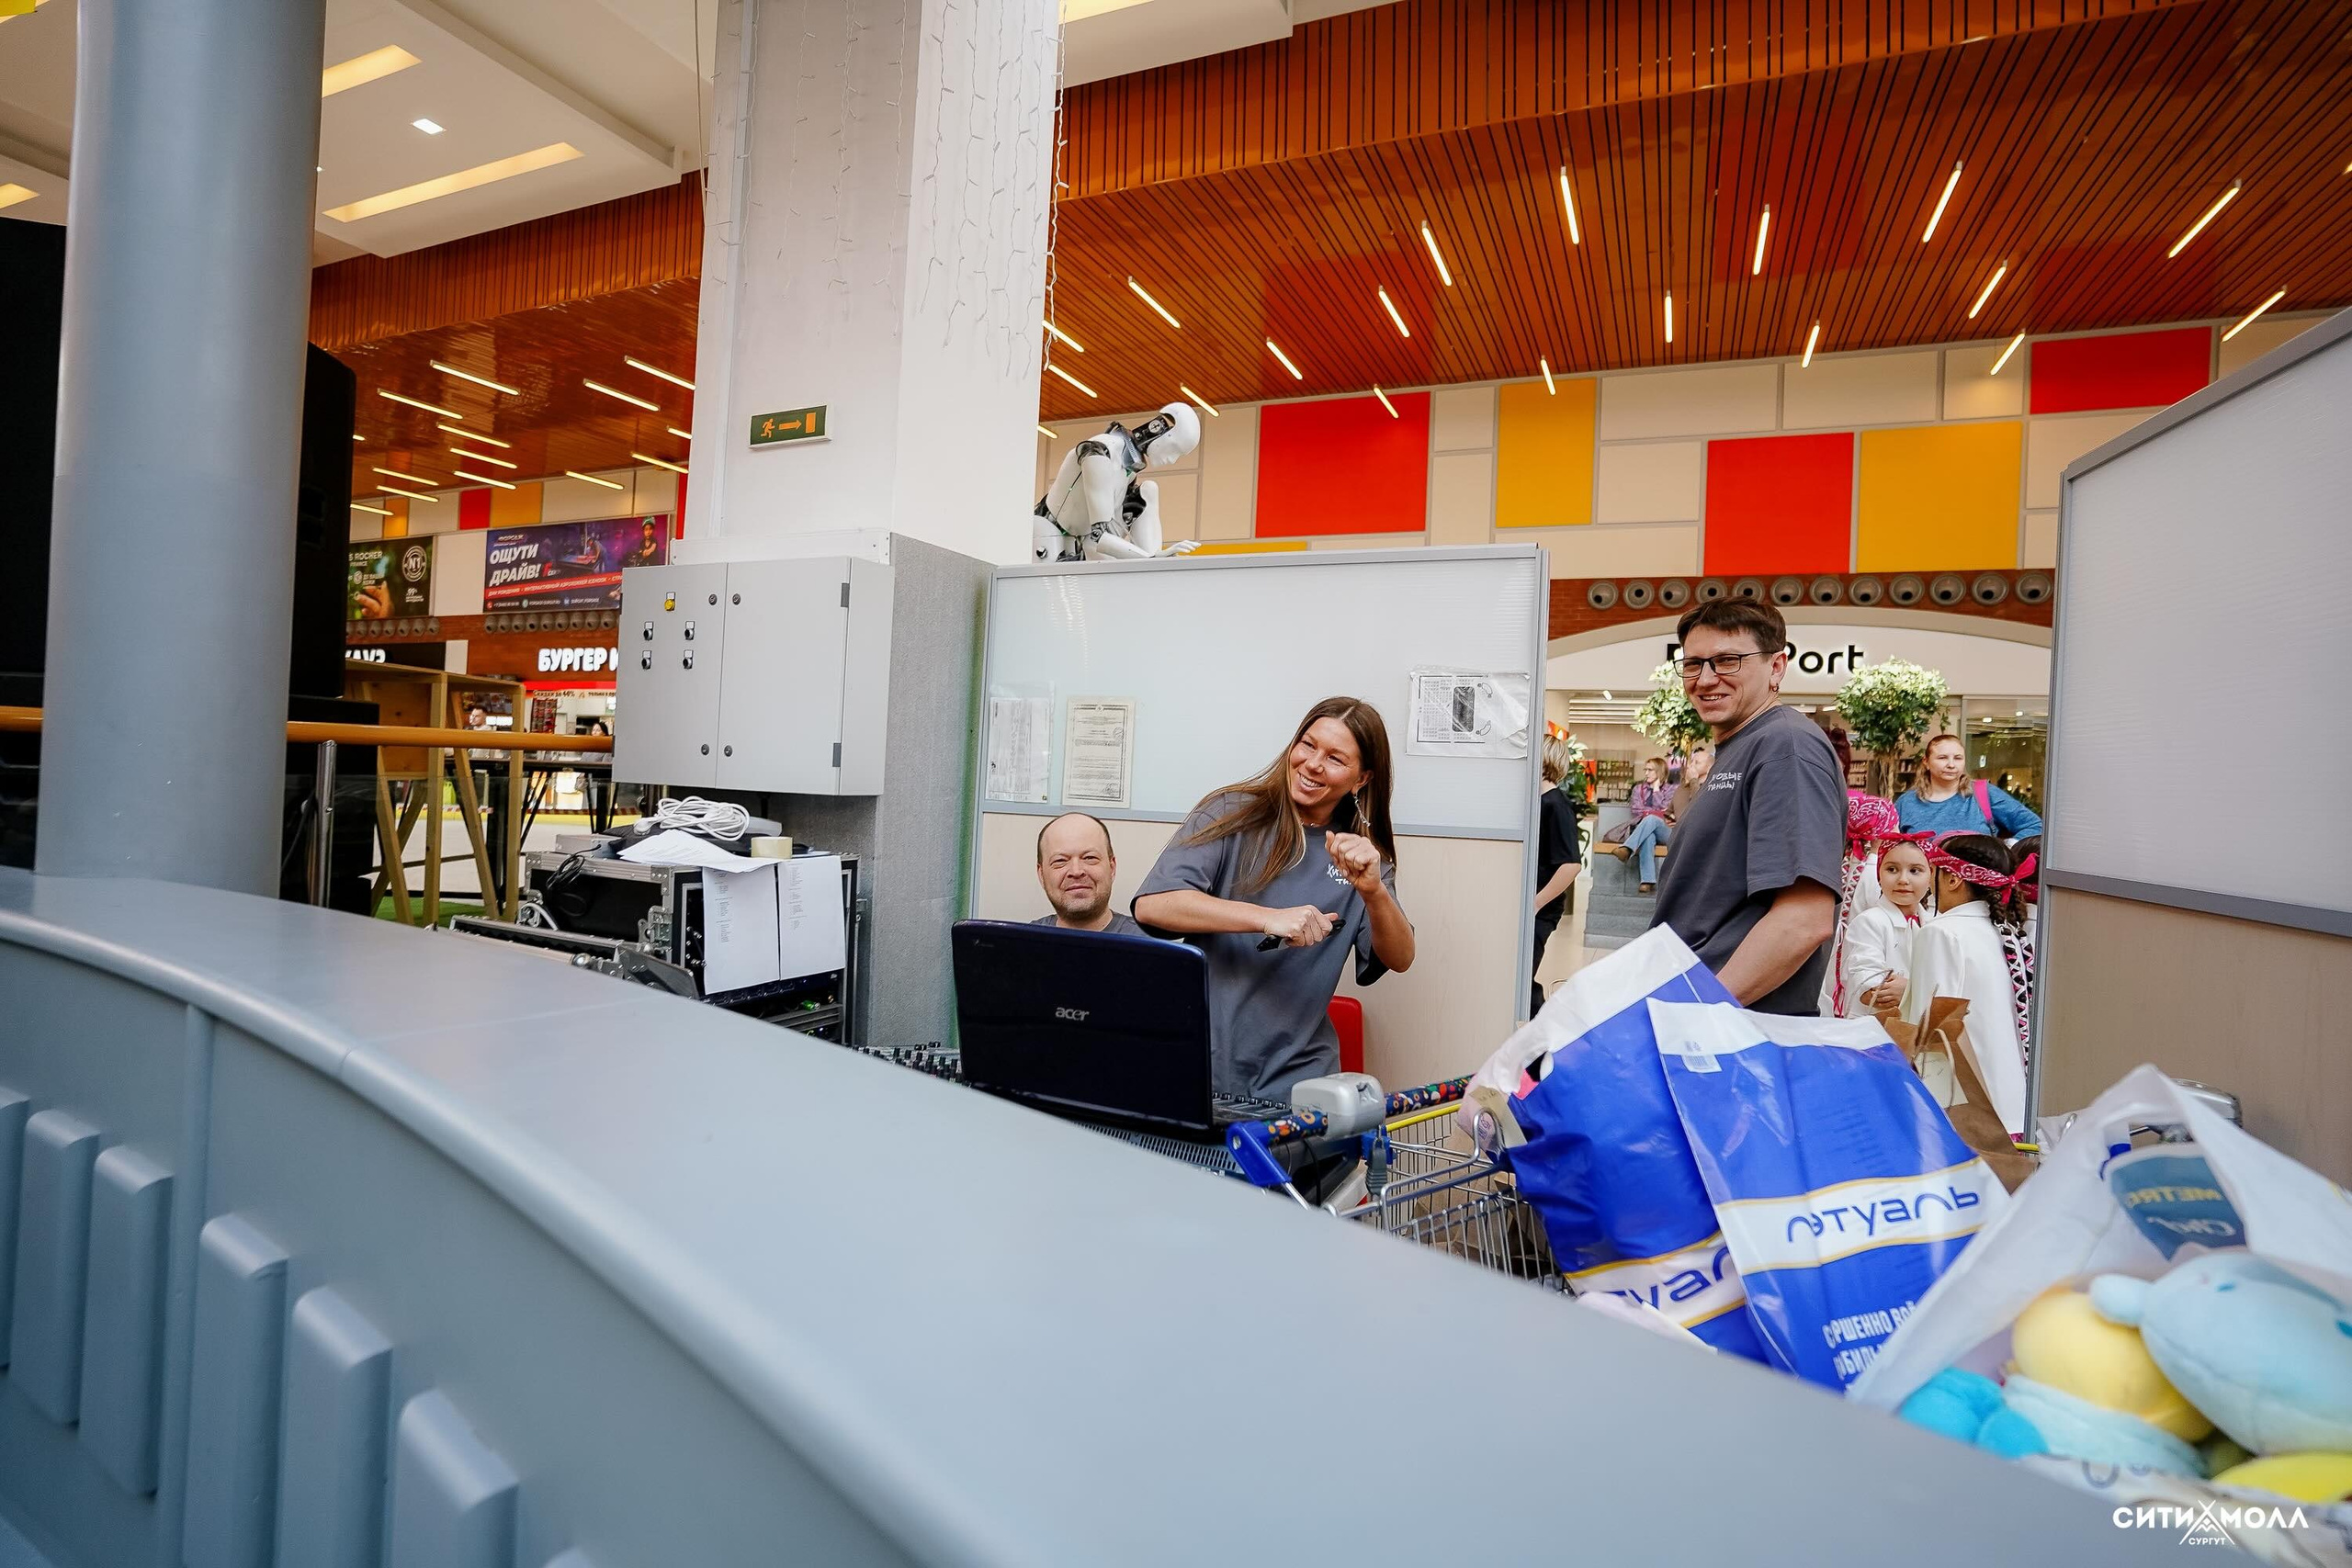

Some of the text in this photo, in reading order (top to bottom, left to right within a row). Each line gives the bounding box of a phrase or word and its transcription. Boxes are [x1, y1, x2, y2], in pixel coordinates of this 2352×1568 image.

[490, 544, 539, 564] ОЩУТИ
[489, 562, 542, 587] ДРАЙВ!
[537, 647, 607, 671] БУРГЕР
[1055, 1007, 1090, 1021] acer
